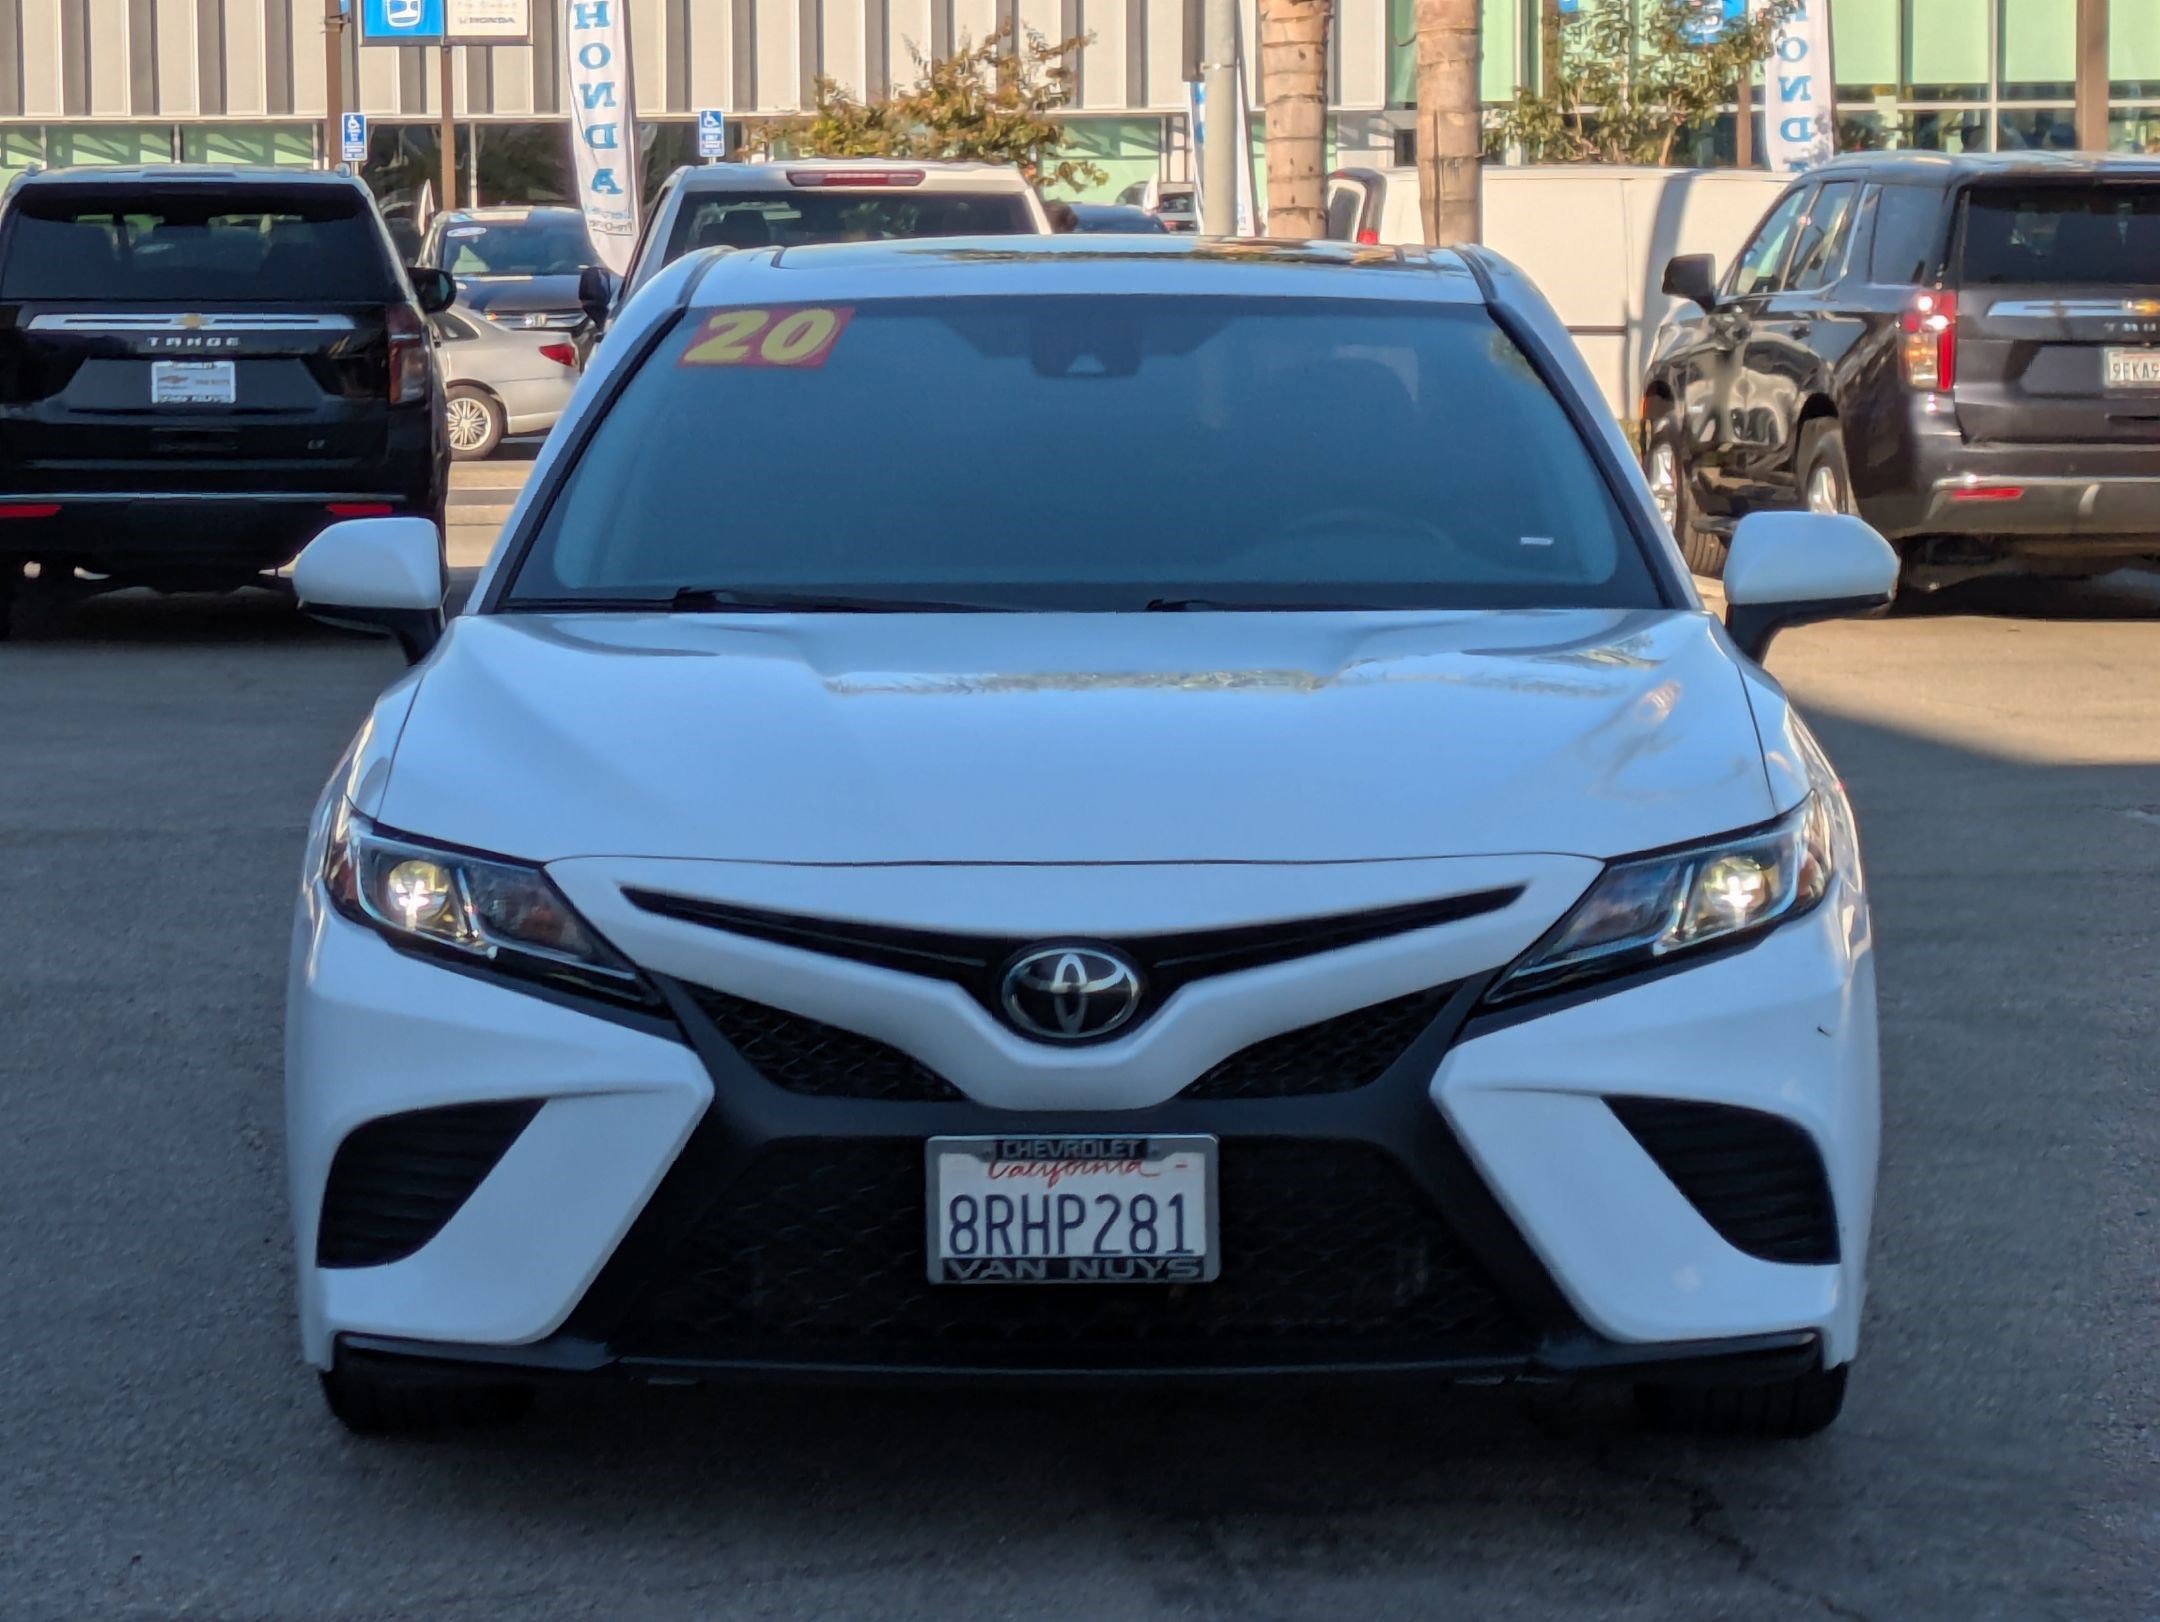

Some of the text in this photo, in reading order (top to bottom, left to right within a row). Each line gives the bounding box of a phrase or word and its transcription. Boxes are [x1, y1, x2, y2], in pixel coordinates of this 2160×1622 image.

[147, 337, 239, 347] TAHOE
[684, 308, 836, 364] 20
[1002, 1139, 1138, 1158] CHEVROLET
[988, 1159, 1160, 1187] California
[949, 1194, 1195, 1255] 8RHP281
[950, 1259, 1201, 1279] VAN NUYS
